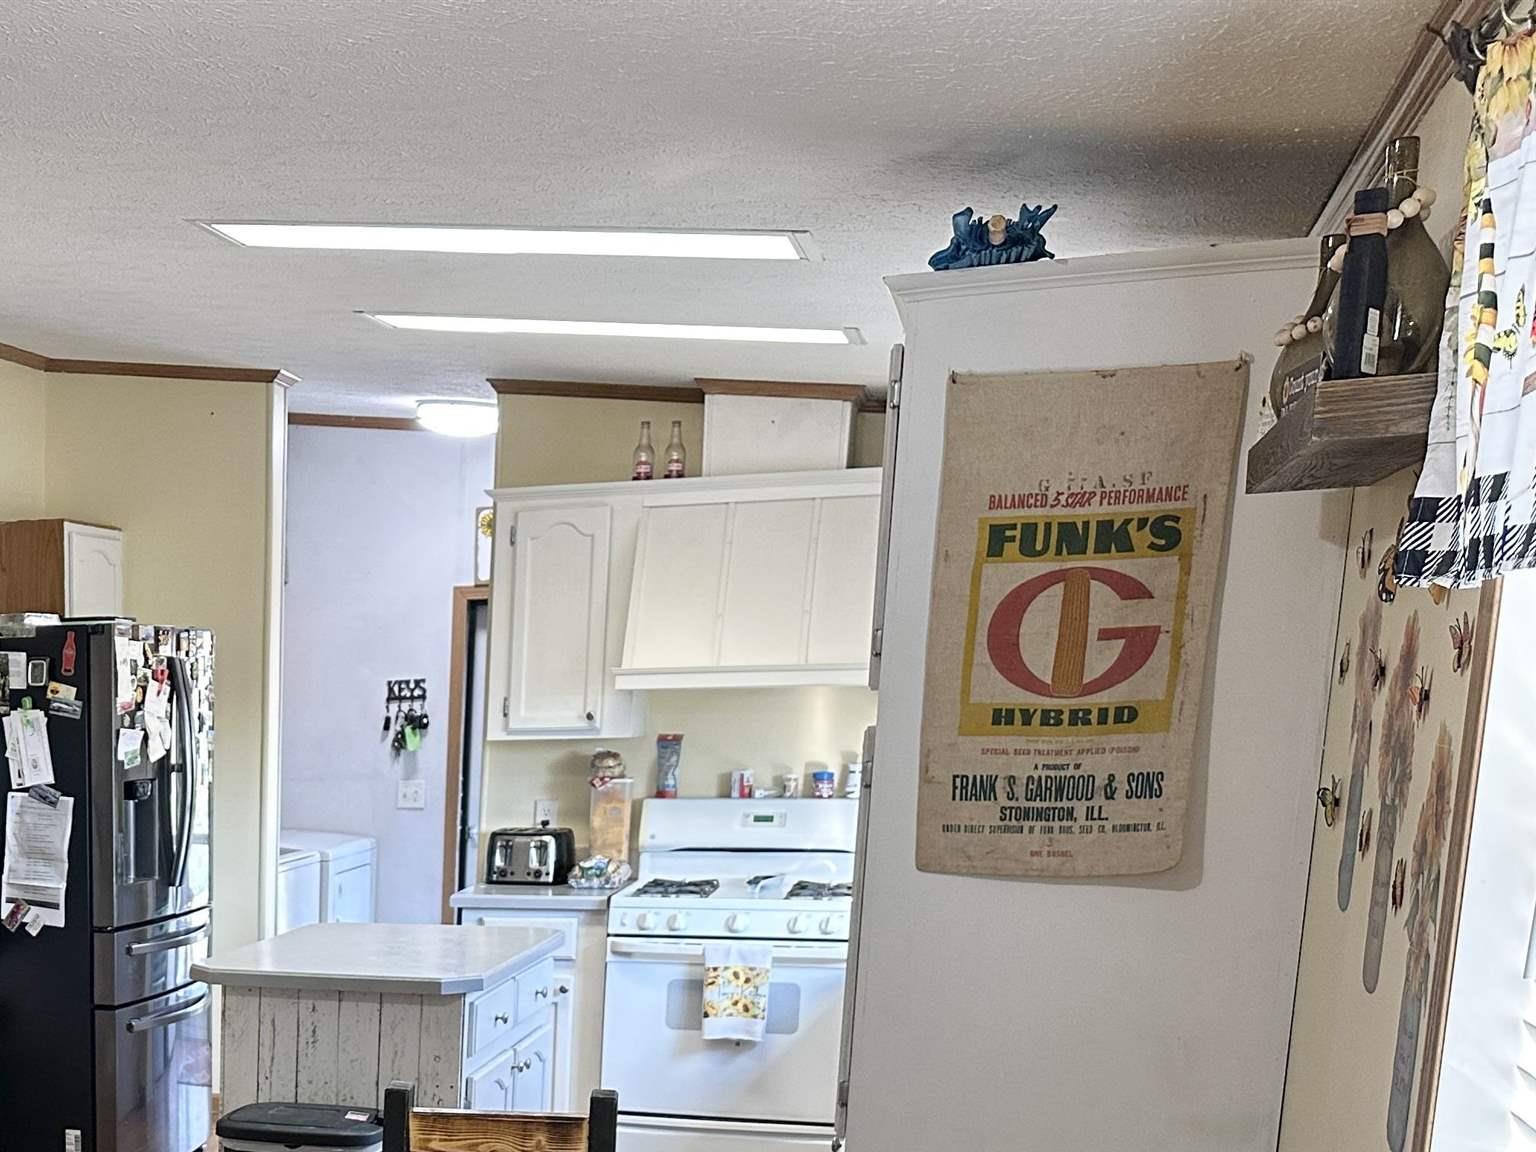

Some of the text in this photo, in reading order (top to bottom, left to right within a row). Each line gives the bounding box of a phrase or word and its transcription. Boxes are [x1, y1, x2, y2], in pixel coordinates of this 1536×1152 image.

[988, 484, 1189, 510] BALANCED 5 STAR PERFORMANCE
[986, 514, 1183, 558] FUNK'S
[987, 566, 1162, 698] G
[387, 678, 426, 698] KEYS
[991, 705, 1139, 727] HYBRID
[1033, 762, 1083, 771] A PRODUCT OF
[951, 771, 1165, 802] FRANK S. GARWOOD & SONS
[999, 805, 1109, 823] STONINGTON, ILL.
